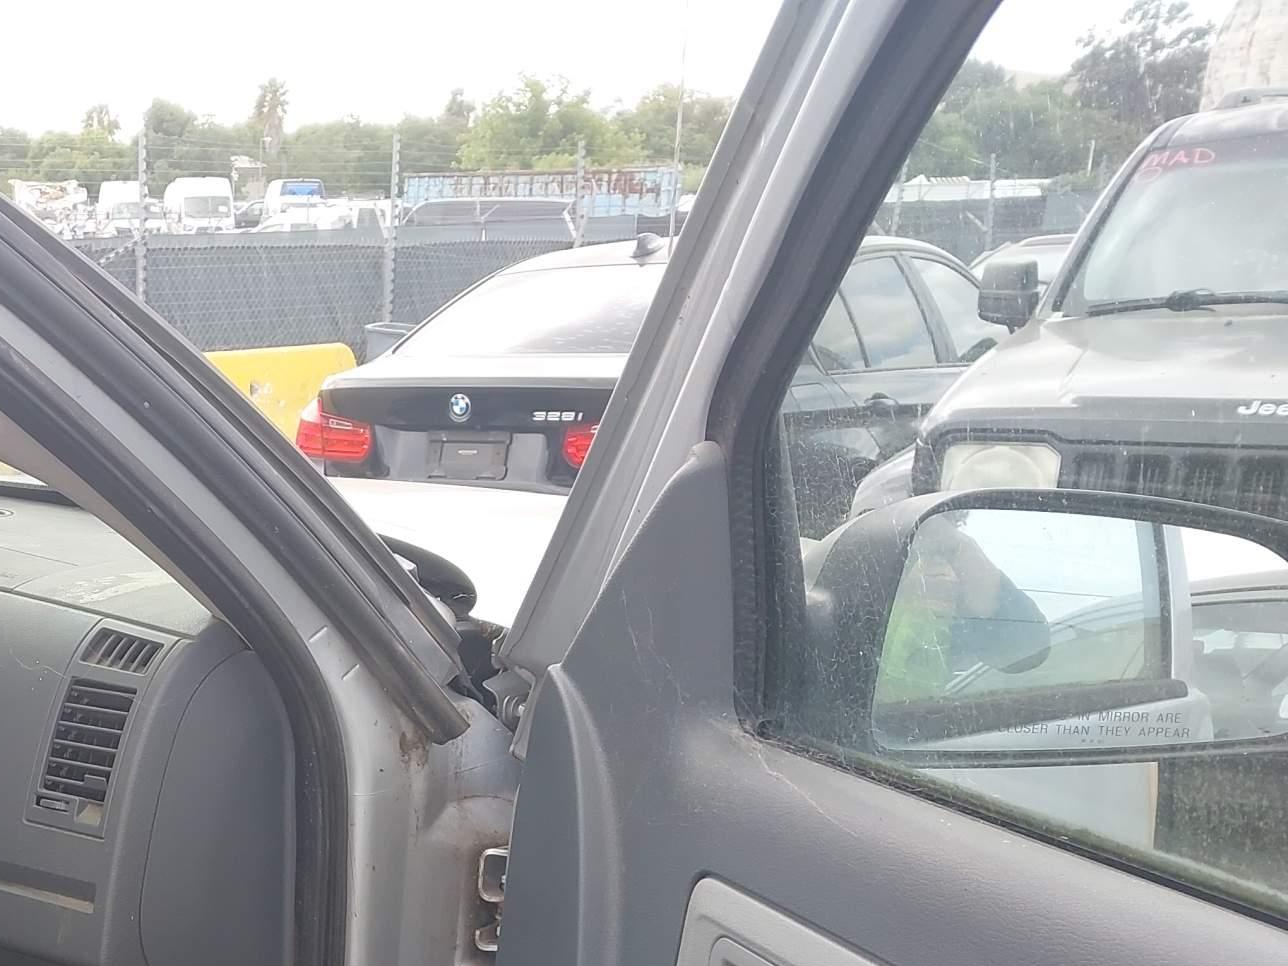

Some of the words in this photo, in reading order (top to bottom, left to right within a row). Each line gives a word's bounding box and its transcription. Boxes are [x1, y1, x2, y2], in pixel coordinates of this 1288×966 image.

[1098, 710, 1150, 723] MIRROR
[1157, 712, 1183, 724] ARE
[1056, 724, 1091, 737] THAN
[1099, 725, 1130, 737] THEY
[1138, 726, 1191, 739] APPEAR
